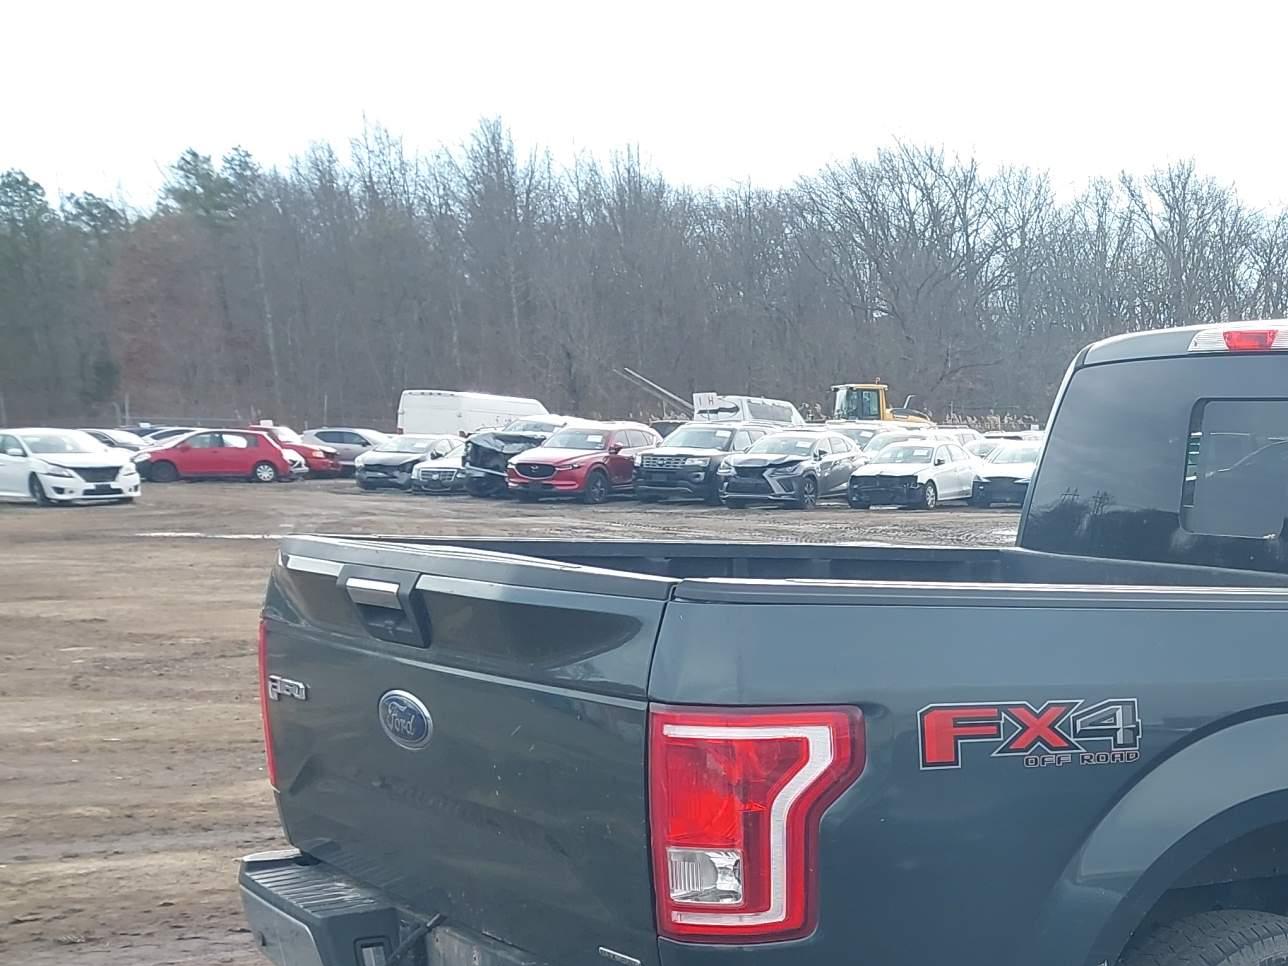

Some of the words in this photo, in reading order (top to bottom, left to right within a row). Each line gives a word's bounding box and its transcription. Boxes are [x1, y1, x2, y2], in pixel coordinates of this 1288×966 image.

[387, 700, 416, 737] Ford
[917, 698, 1142, 770] FX4
[1024, 753, 1072, 767] OFF
[1080, 751, 1140, 766] ROAD
